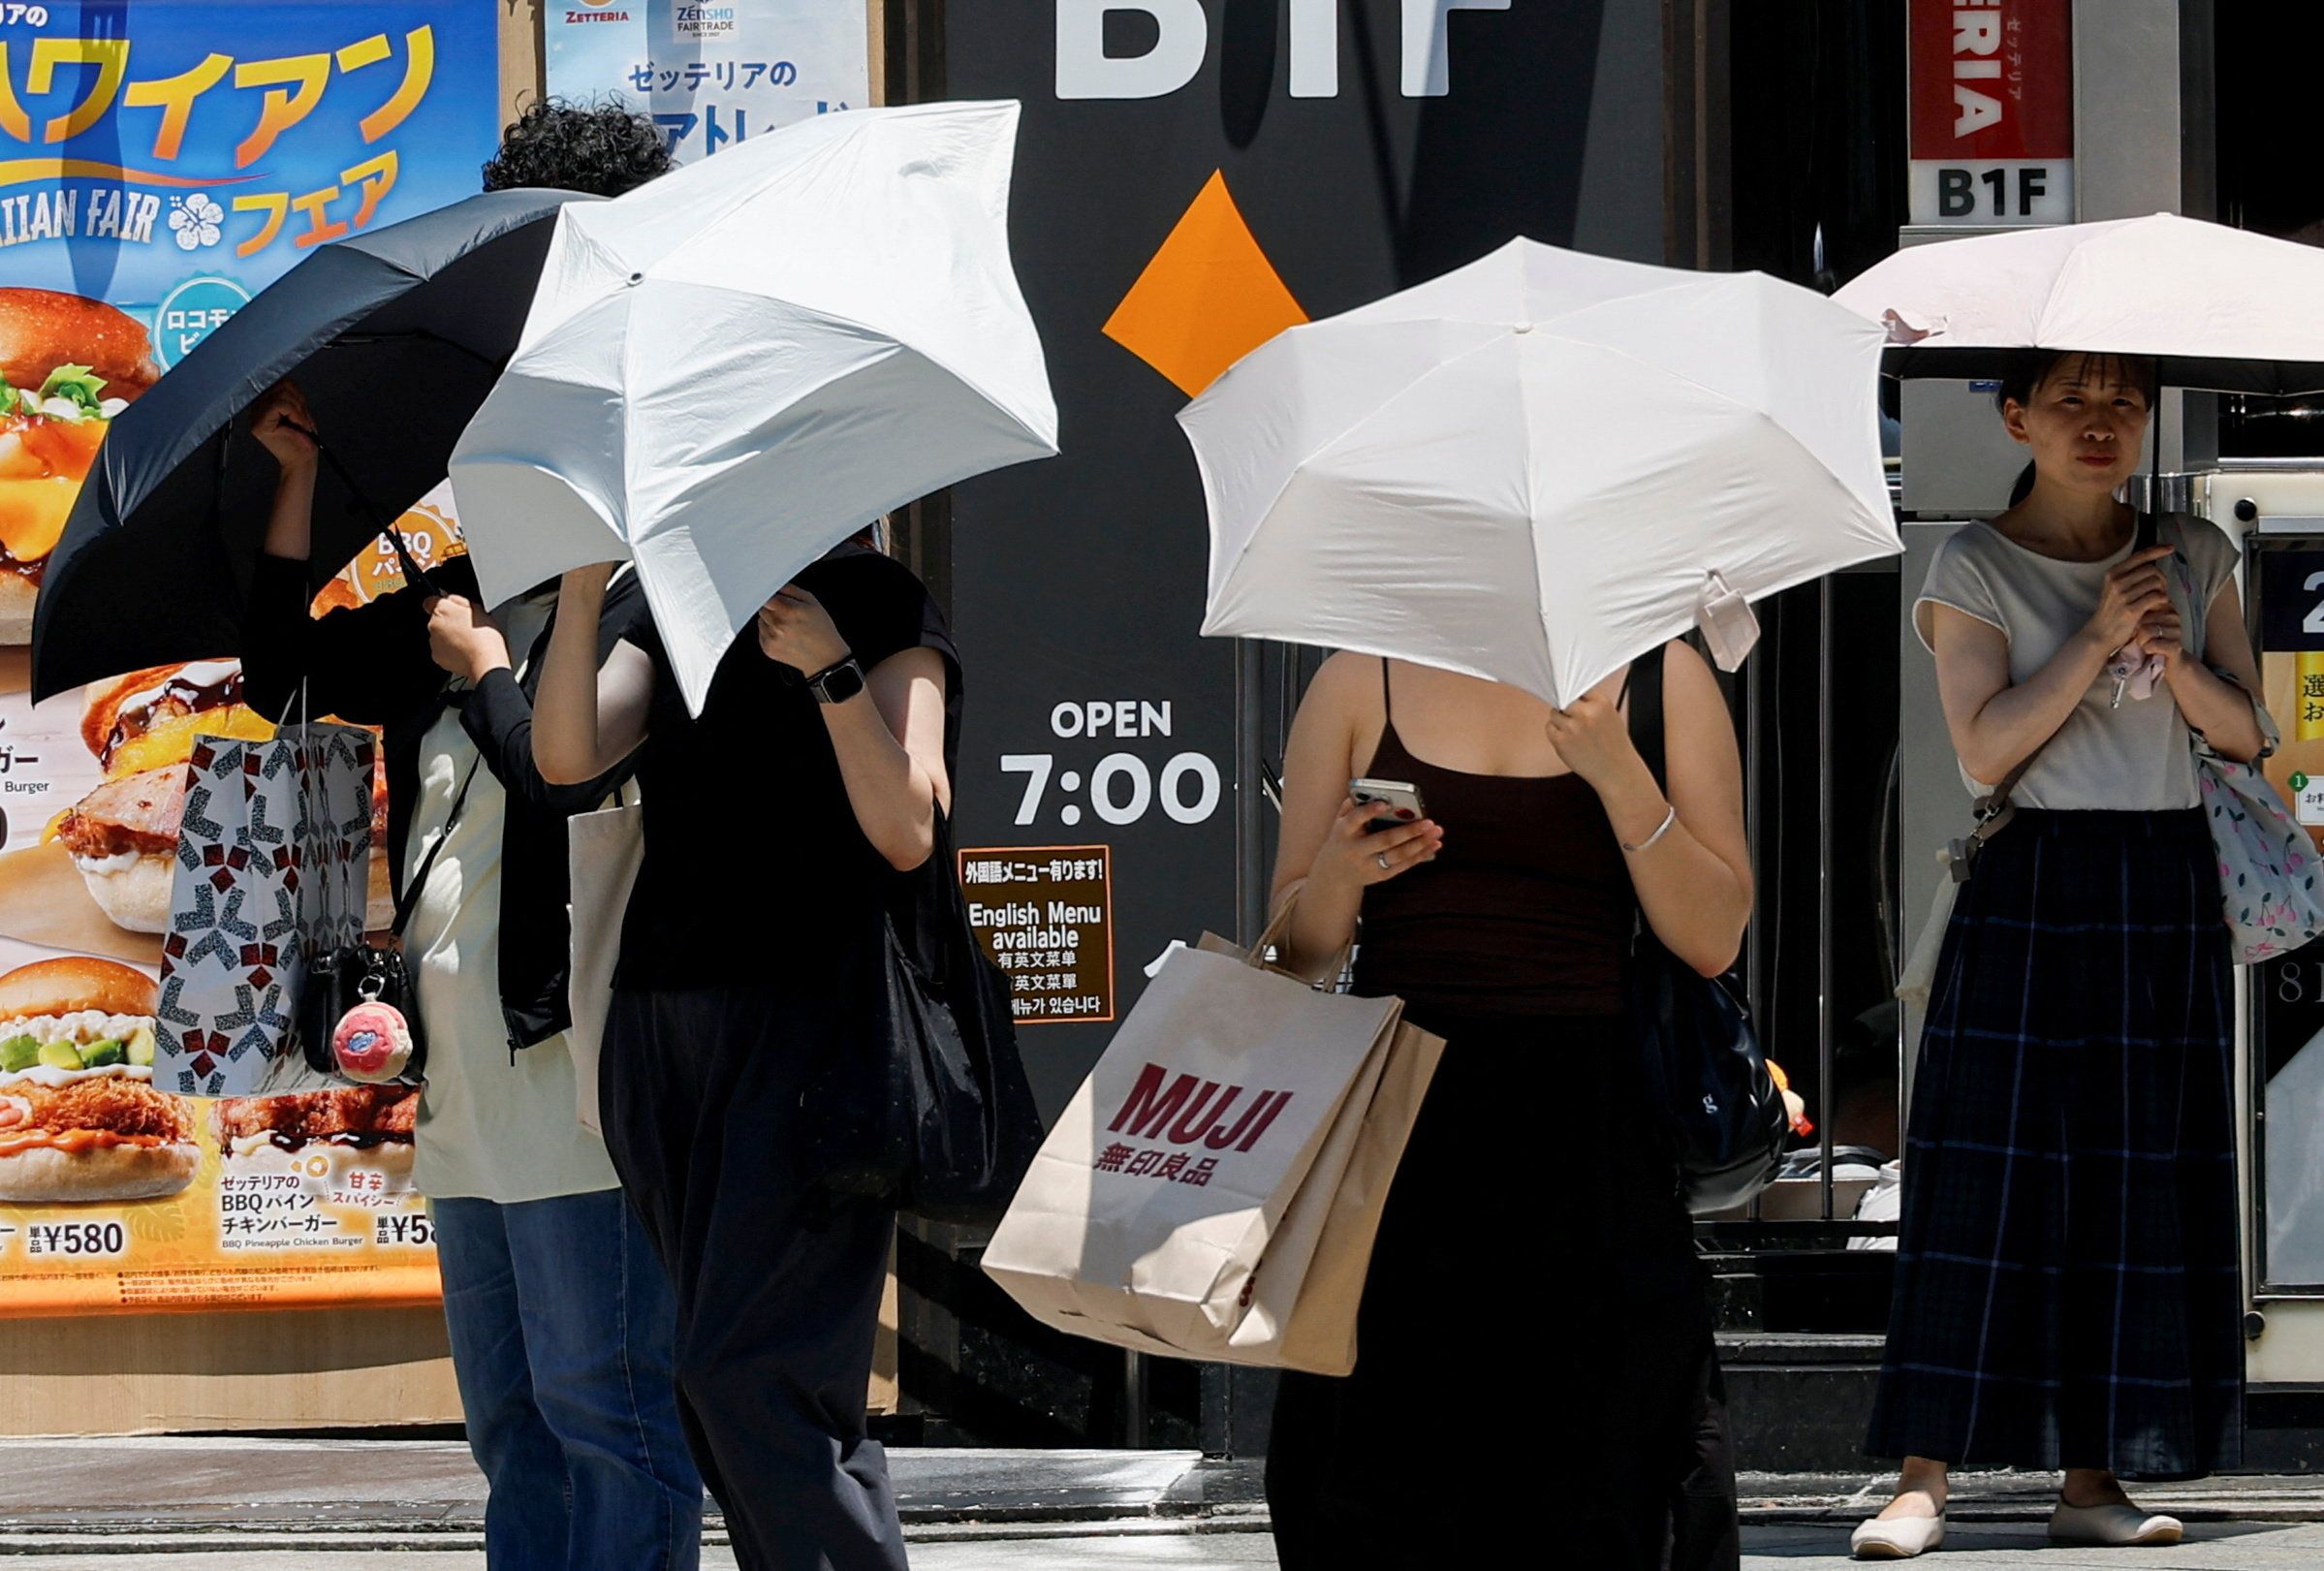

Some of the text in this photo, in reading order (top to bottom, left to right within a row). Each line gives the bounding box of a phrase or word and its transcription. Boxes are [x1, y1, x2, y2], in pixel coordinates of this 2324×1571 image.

[566, 11, 630, 24] ZETTERIA
[628, 60, 798, 92] ゼッテリアの
[1953, 0, 2002, 139] RIA
[232, 149, 398, 260] フェア
[1938, 168, 2047, 217] B1F
[0, 189, 161, 247] IIAN FAIR
[168, 308, 237, 330] ロコモ
[1051, 700, 1172, 738] OPEN
[5, 781, 49, 794] Burger
[1000, 751, 1221, 826] 7:00
[969, 900, 1102, 928] English Menu
[992, 925, 1080, 950] available
[997, 951, 1078, 969] 有英文菜单
[1010, 973, 1078, 991] 英文菜單
[1049, 995, 1101, 1015] 있습니다
[1107, 1062, 1294, 1153] MUJI
[1091, 1143, 1219, 1187] 無印良品
[221, 1175, 300, 1191] ゼッテリアの
[348, 1171, 383, 1191] 甘辛
[222, 1213, 338, 1236] チキンバーガー
[222, 1236, 363, 1248] BBQ Pineapple Chicken Burger
